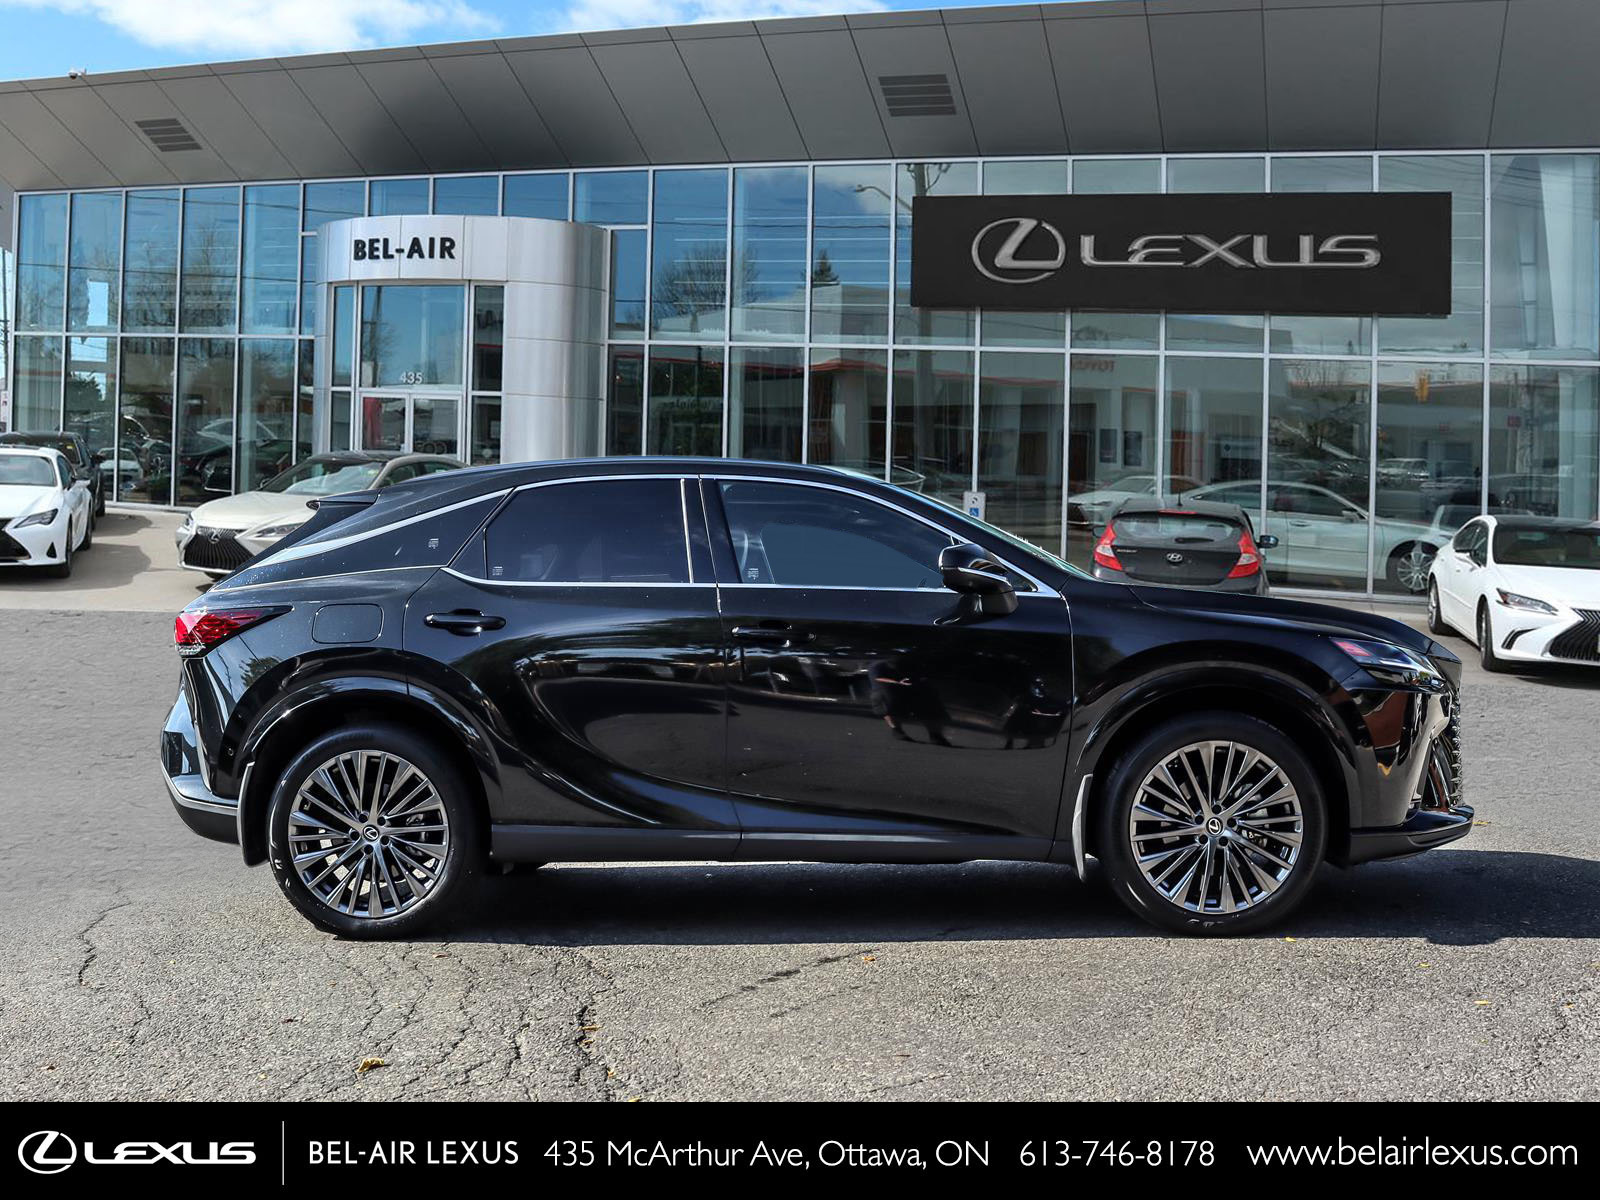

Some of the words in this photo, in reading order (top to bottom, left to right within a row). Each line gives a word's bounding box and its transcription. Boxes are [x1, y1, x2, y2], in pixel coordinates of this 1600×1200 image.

[353, 236, 457, 261] BEL-AIR
[1080, 234, 1381, 268] LEXUS
[400, 371, 423, 384] 435
